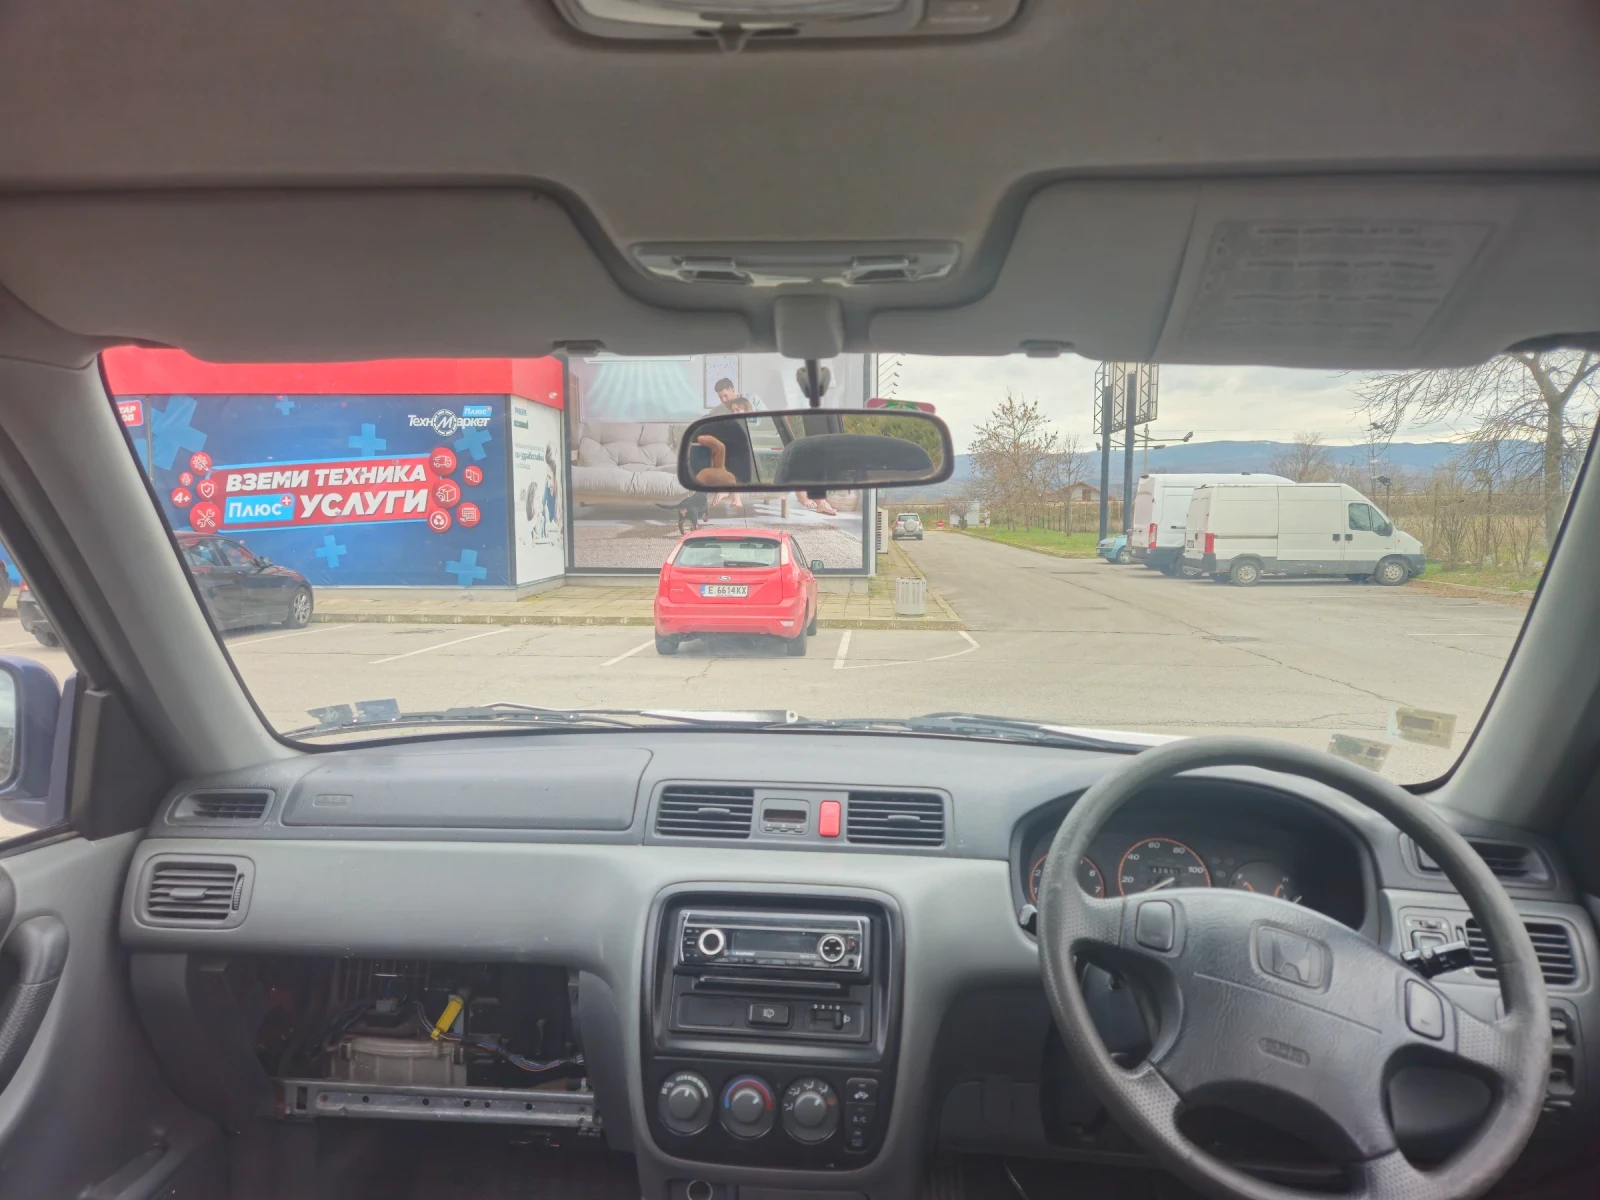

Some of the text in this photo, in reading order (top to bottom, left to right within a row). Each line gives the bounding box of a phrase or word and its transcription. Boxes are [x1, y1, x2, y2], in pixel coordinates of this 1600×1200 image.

[119, 405, 136, 414] ТАР
[226, 464, 426, 492] ВЗЕМИ ТЕХНИКА
[300, 489, 428, 518] УСЛУГИ
[1188, 866, 1204, 874] 100
